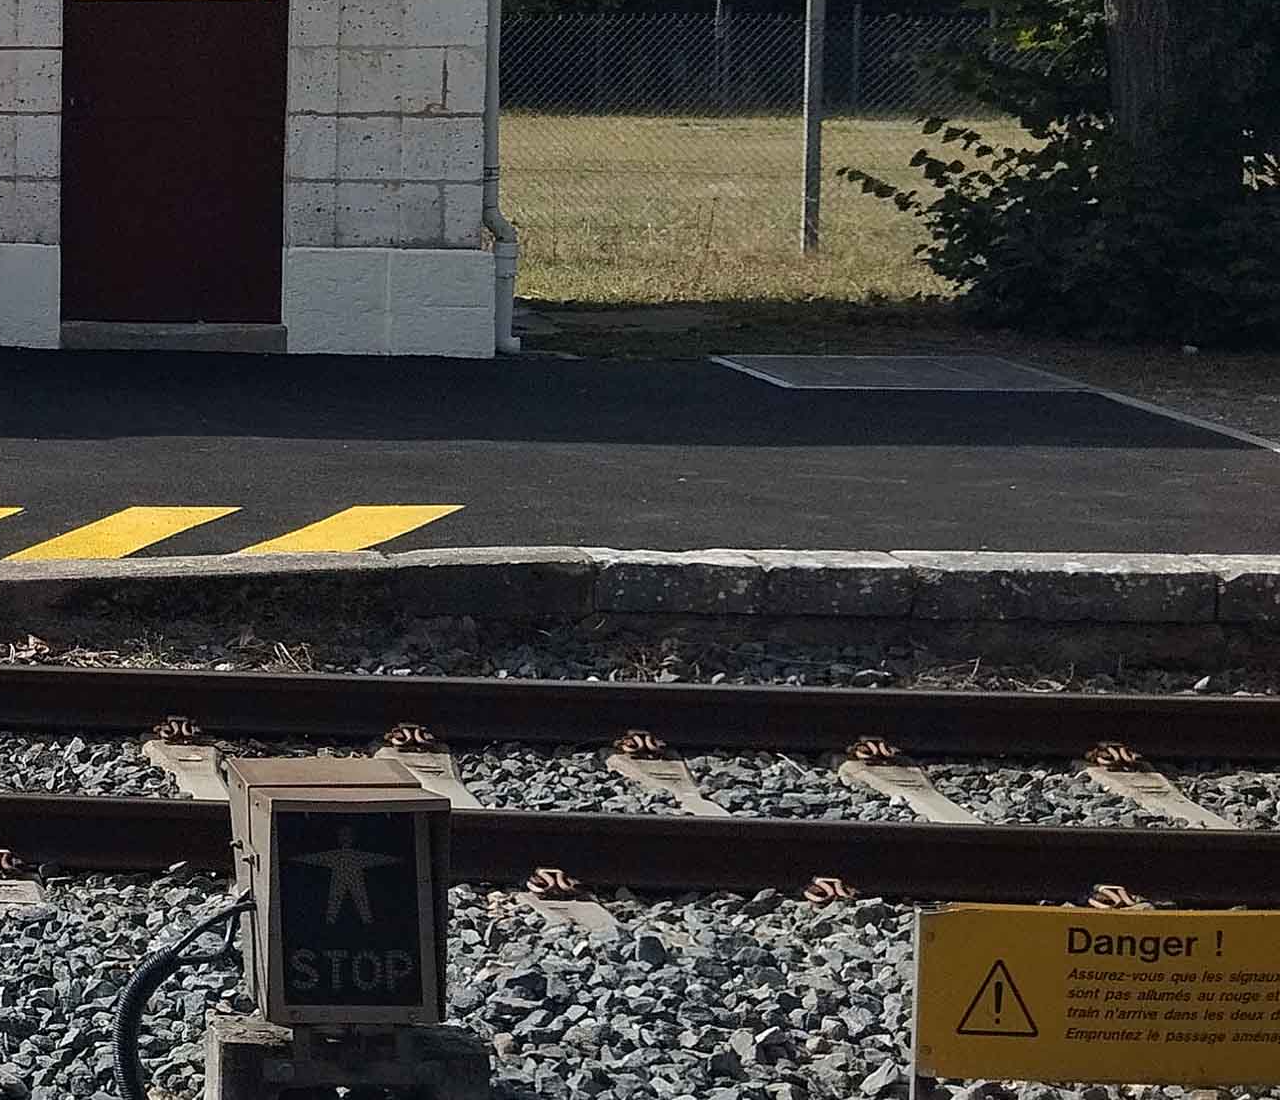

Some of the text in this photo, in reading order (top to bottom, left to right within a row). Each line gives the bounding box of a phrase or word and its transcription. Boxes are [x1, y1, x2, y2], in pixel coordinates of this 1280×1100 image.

[1067, 926, 1225, 964] Danger !
[289, 948, 415, 992] STOP
[1067, 968, 1165, 982] Assurez-vous
[1170, 972, 1198, 984] que
[1201, 970, 1224, 982] les
[1066, 986, 1100, 1000] sont
[1103, 989, 1130, 1002] pas
[1136, 986, 1192, 1002] allumés
[1197, 992, 1216, 1002] au
[1219, 990, 1260, 1005] rouge
[1066, 1006, 1100, 1020] train
[1104, 1007, 1159, 1021] n'arrive
[1163, 1007, 1200, 1021] dans
[1203, 1007, 1224, 1021] les
[1230, 1007, 1264, 1021] deux
[1065, 1026, 1144, 1042] Empruntez
[1147, 1027, 1160, 1041] le
[1165, 1029, 1227, 1045] passage
